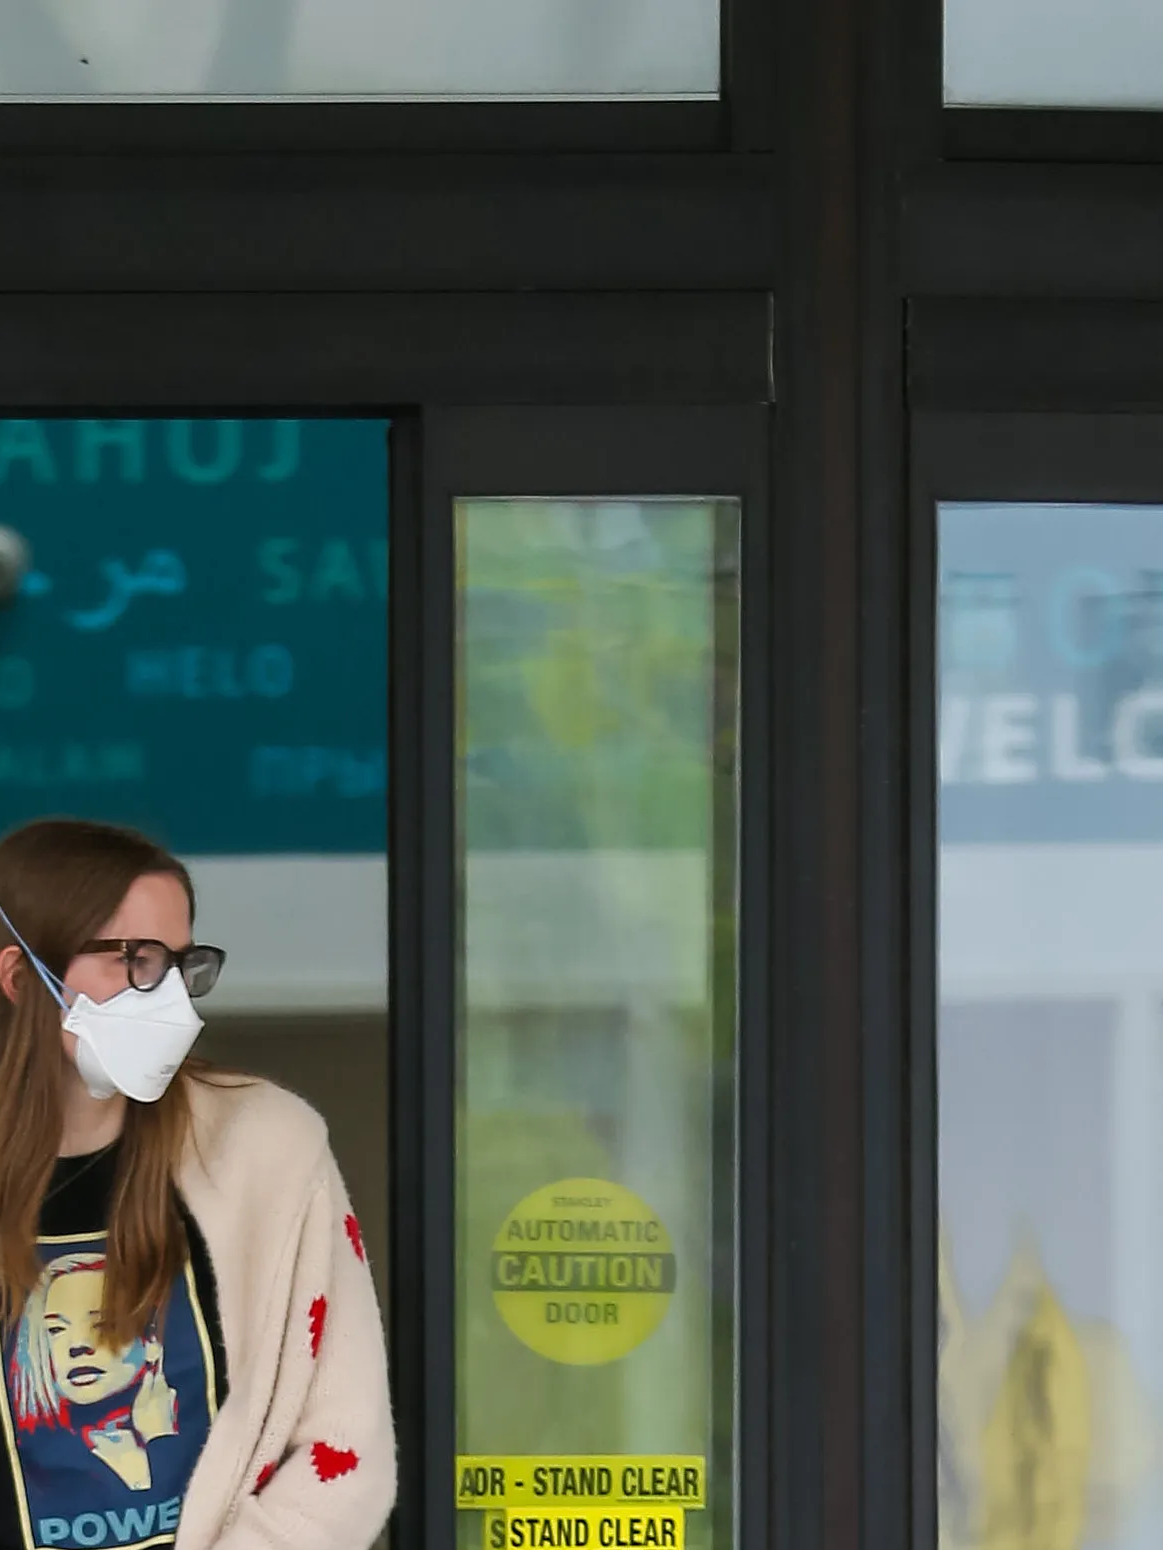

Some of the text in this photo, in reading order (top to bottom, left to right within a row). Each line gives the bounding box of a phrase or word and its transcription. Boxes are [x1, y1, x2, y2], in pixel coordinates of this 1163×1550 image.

[507, 1220, 660, 1243] AUTOMATIC
[498, 1255, 663, 1288] CAUTION
[546, 1302, 619, 1325] DOOR
[532, 1467, 612, 1497] STAND
[621, 1467, 700, 1498] CLEAR
[598, 1518, 677, 1549] CLEAR
